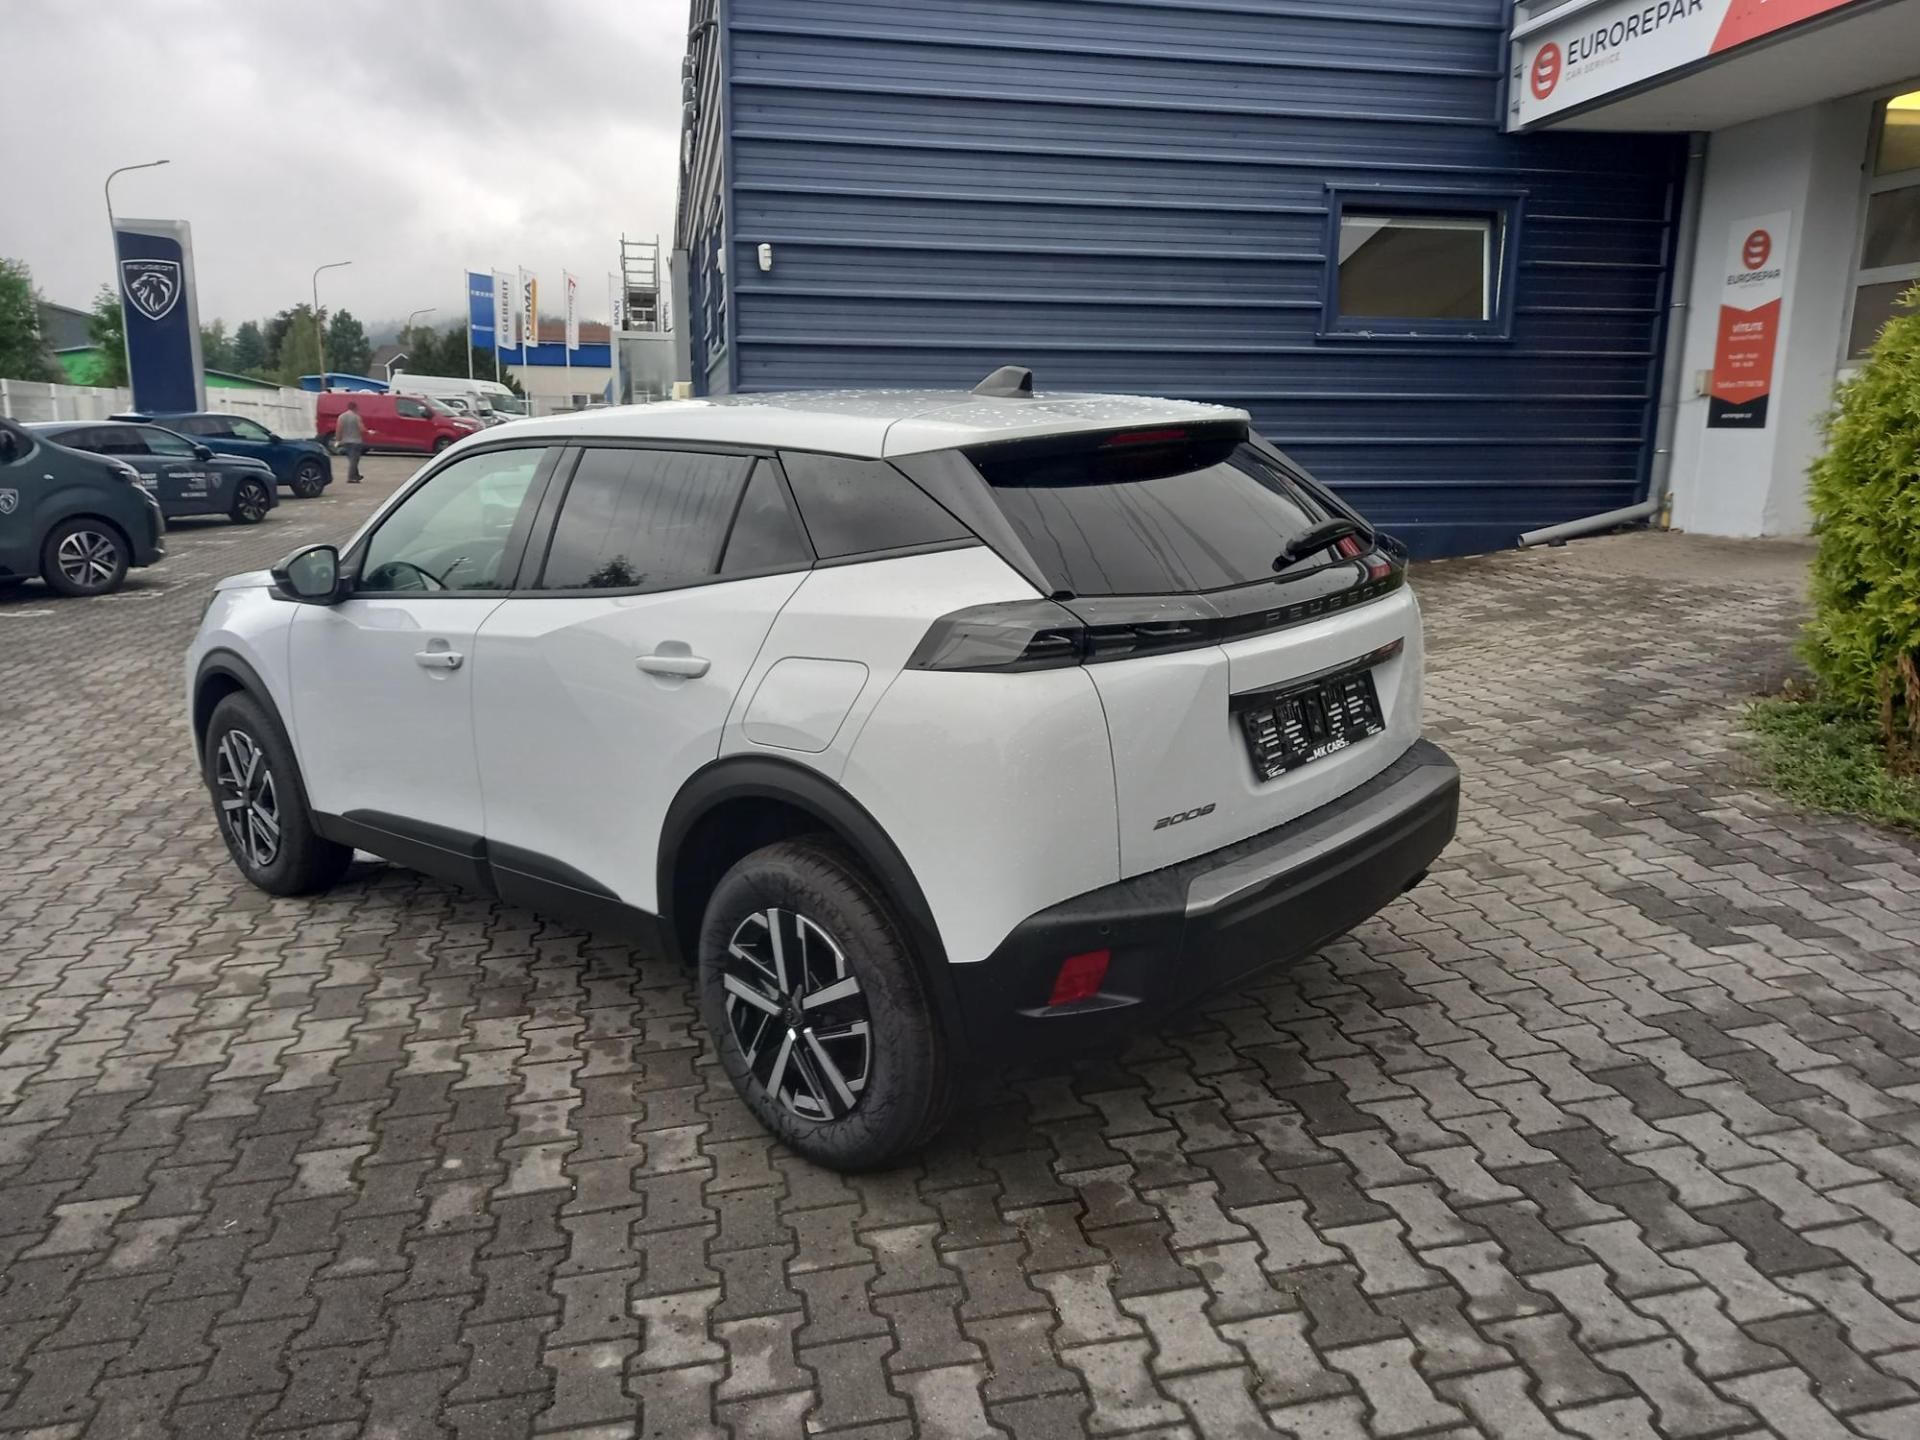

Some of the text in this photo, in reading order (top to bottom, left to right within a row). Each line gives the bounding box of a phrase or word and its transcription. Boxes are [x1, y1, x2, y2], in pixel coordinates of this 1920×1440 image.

[1567, 0, 1703, 66] EUROREPAR
[1727, 268, 1781, 285] EUROREPAR
[1153, 802, 1216, 831] 2008
